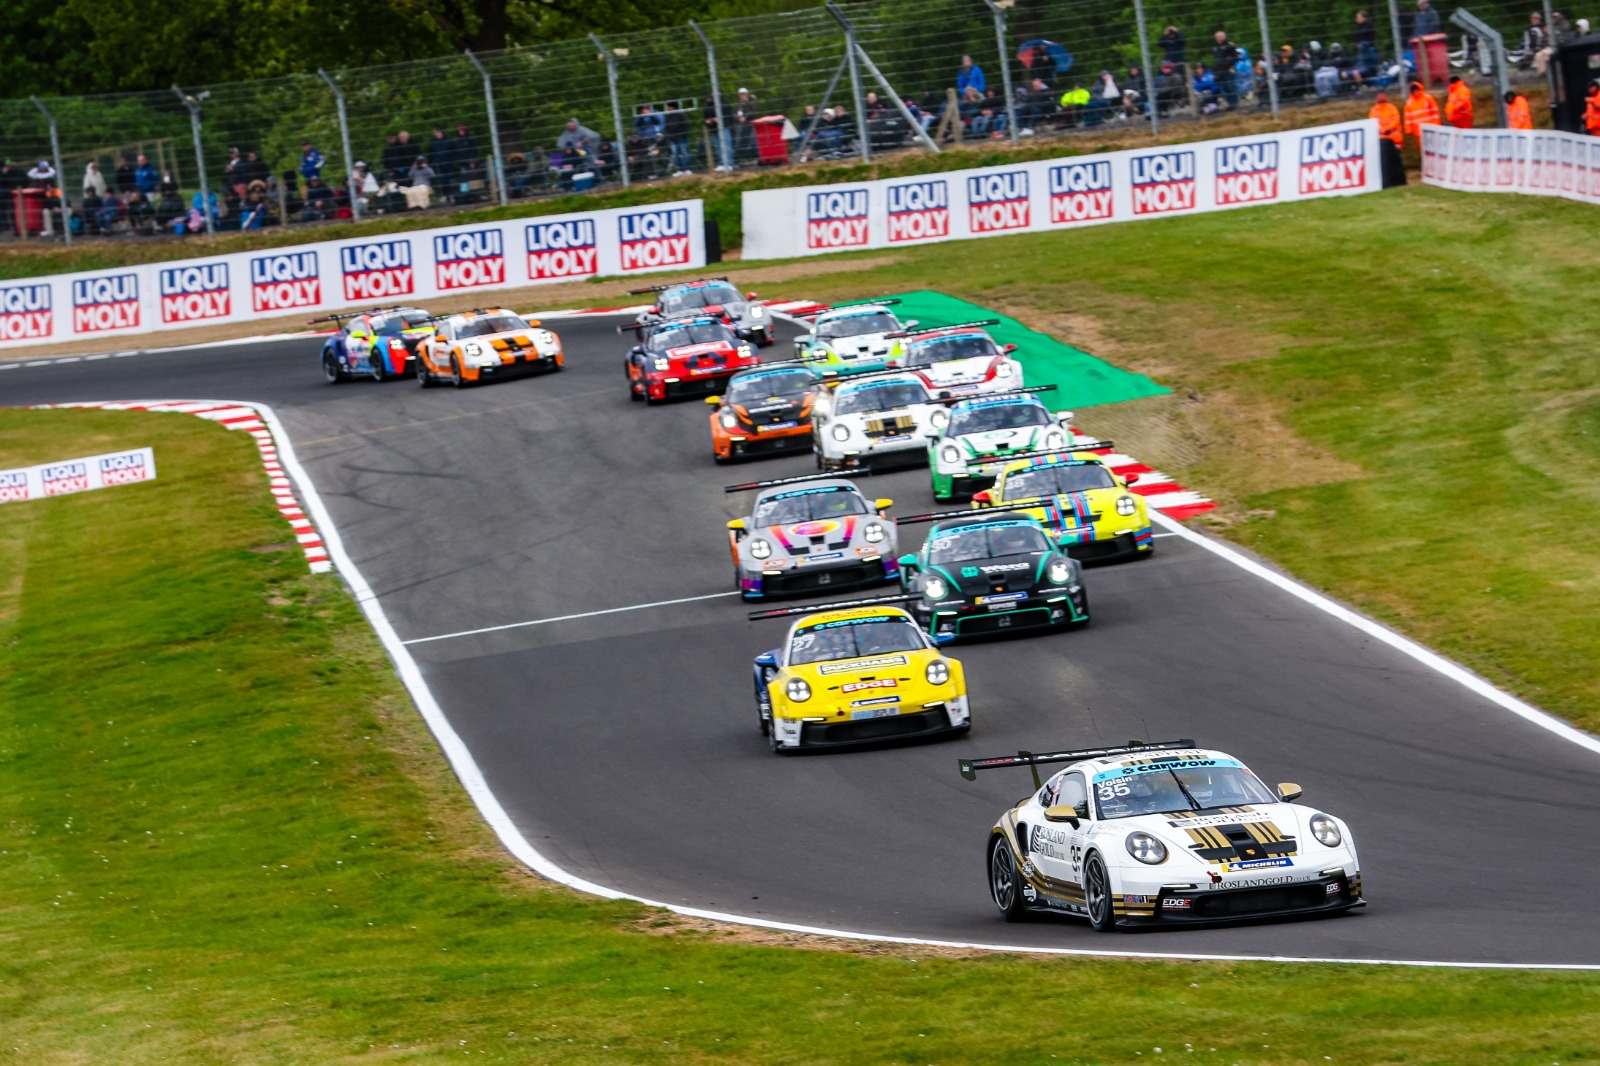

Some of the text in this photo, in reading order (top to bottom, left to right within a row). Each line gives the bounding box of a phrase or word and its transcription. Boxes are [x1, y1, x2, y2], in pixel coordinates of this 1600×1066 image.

[1217, 143, 1277, 174] LIQUI
[1302, 131, 1363, 164] LIQUI
[1052, 163, 1110, 193] LIQUI
[1133, 154, 1194, 184] LIQUI
[1302, 159, 1365, 192] MOLY
[889, 182, 945, 212] LIQUI
[970, 173, 1027, 203] LIQUI
[1134, 182, 1194, 213] MOLY
[1217, 171, 1277, 203] MOLY
[810, 191, 866, 219] LIQUI
[971, 201, 1029, 231] MOLY
[1053, 191, 1112, 221] MOLY
[528, 221, 595, 250] LIQUI
[621, 211, 687, 240] LIQUI
[810, 218, 867, 247] MOLY
[890, 211, 947, 240] MOLY
[342, 242, 410, 271] LIQUI
[437, 231, 502, 260] LIQUI
[622, 238, 690, 268] MOLY
[254, 253, 317, 282] LIQUI
[437, 258, 503, 288] MOLY
[530, 248, 597, 278] MOLY
[74, 276, 136, 305] LIQUI
[163, 265, 228, 294] LIQUI
[345, 269, 412, 299] MOLY
[0, 286, 50, 313] IQUI
[164, 292, 229, 321] MOLY
[255, 281, 319, 310] MOLY
[75, 303, 138, 331] MOLY
[43, 463, 85, 481] LIQUI
[101, 454, 144, 471] LIQUI
[103, 467, 146, 484] MOLY
[0, 486, 28, 500] OLY
[45, 476, 87, 494] MOLY
[826, 616, 890, 628] carwow
[843, 679, 896, 692] EDGE
[1137, 760, 1216, 772] carwow
[1097, 776, 1132, 788] Voisin
[1099, 783, 1131, 801] 35
[1070, 845, 1082, 872] 35
[1242, 860, 1286, 869] MICHELIN
